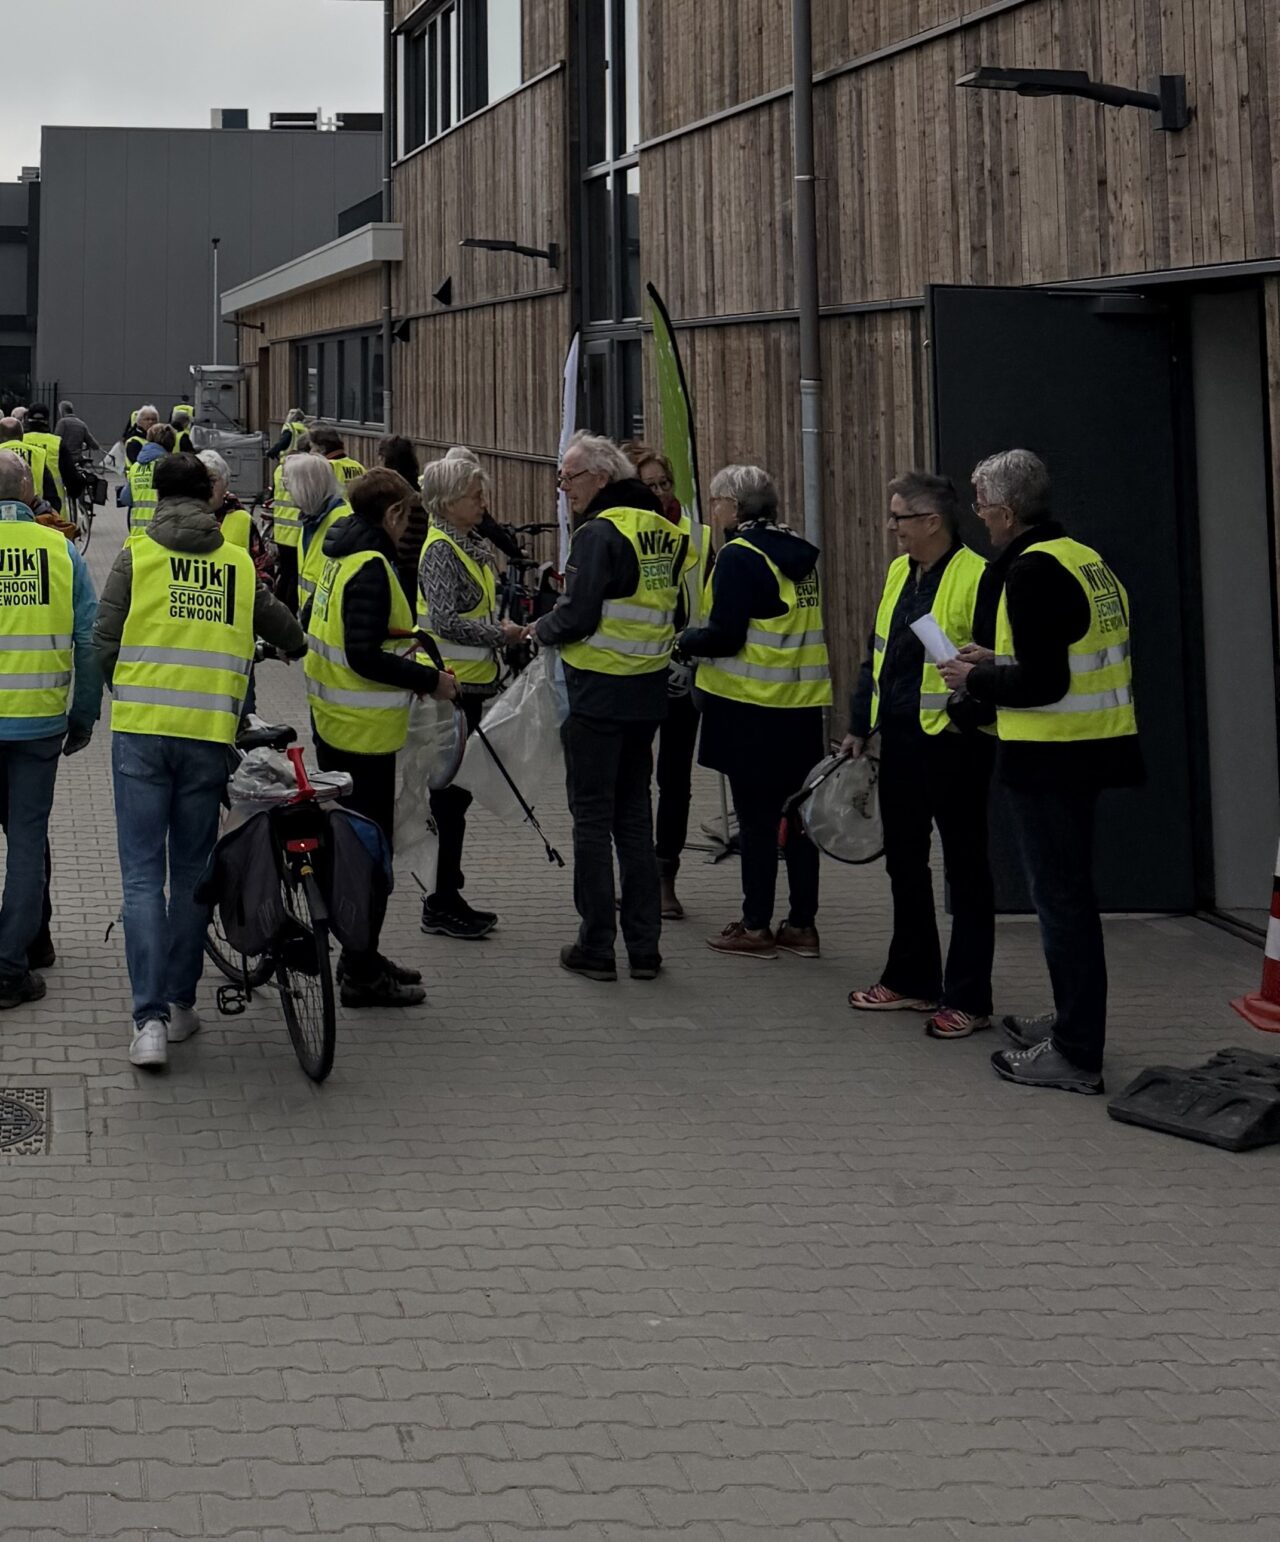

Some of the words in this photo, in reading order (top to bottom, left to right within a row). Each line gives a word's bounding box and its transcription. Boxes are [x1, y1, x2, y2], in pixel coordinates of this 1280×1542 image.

[170, 557, 223, 590] Wijk
[170, 591, 222, 609] SCHOON
[169, 605, 222, 623] GEWOON
